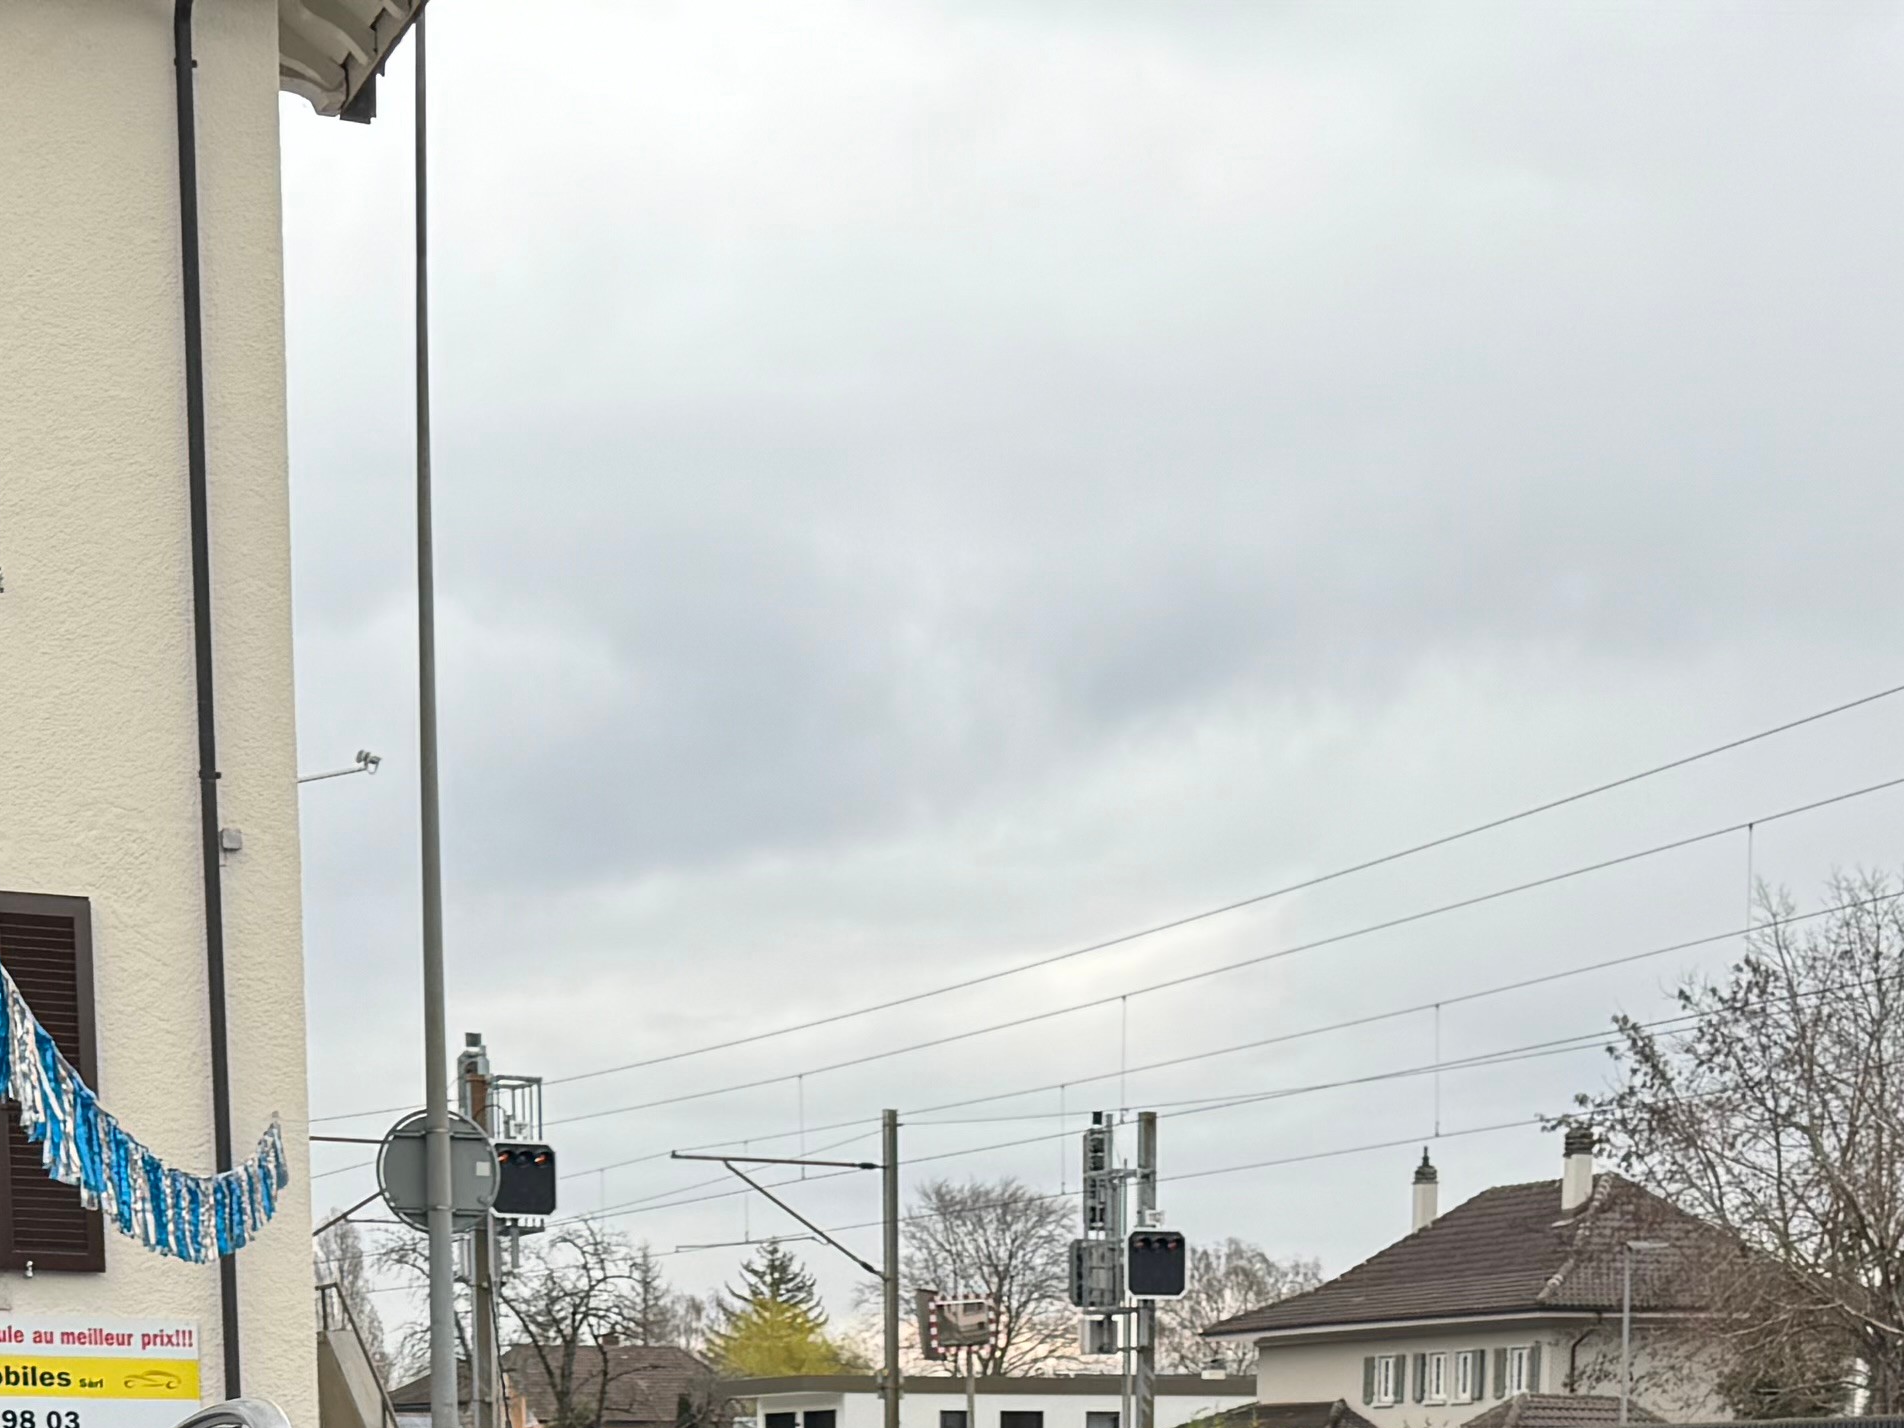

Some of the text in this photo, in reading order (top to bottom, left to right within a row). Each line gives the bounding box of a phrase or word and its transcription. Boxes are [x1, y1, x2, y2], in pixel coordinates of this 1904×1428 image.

[32, 1329, 54, 1345] au
[60, 1328, 133, 1346] meilleur
[141, 1329, 194, 1350] prix!!!
